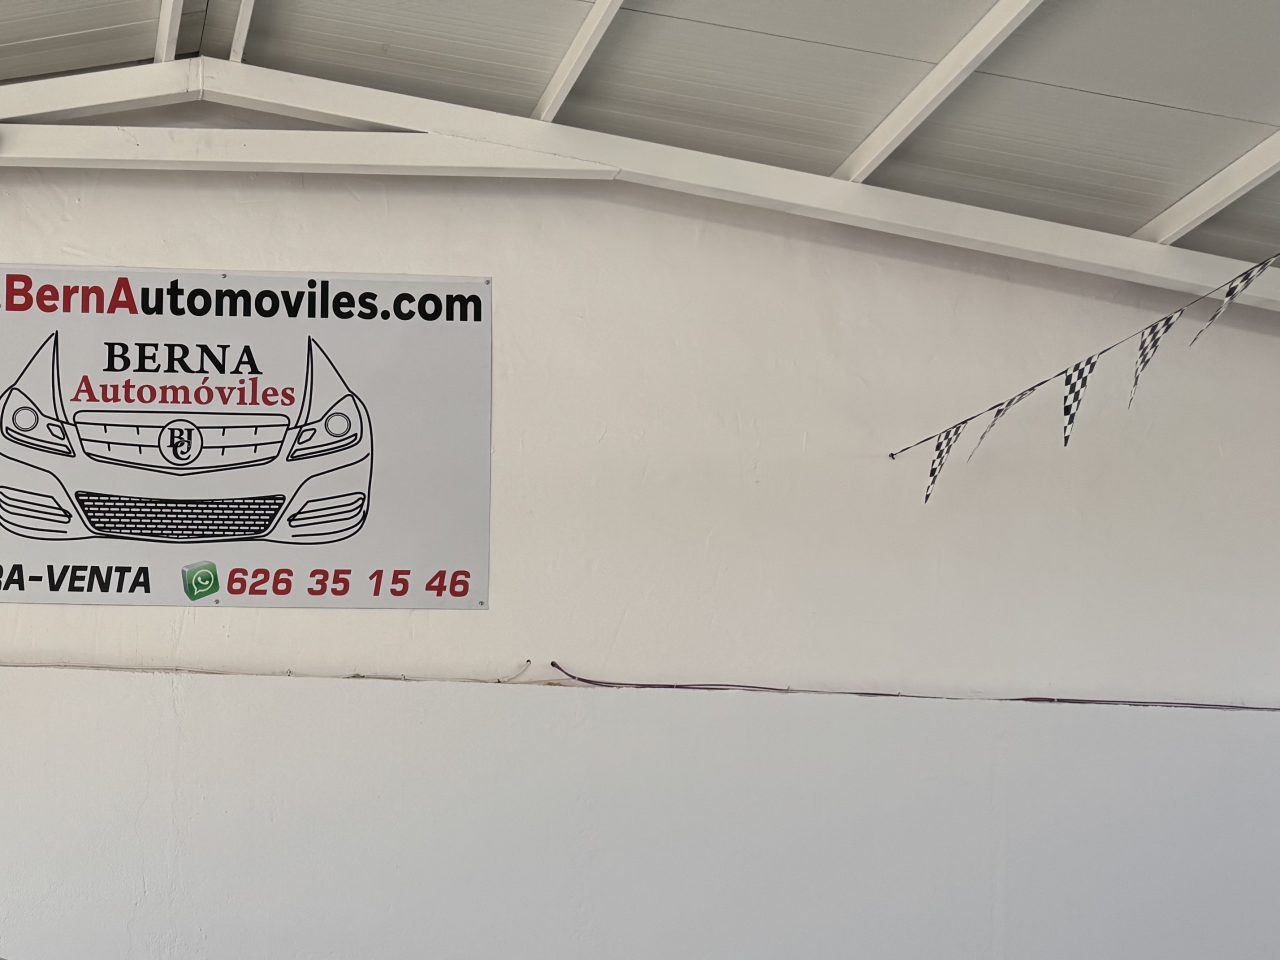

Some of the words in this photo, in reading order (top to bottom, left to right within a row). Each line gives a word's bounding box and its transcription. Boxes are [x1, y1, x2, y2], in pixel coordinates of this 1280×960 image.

[103, 342, 263, 375] BERNA
[70, 372, 296, 407] Automóviles
[226, 568, 293, 596] 626
[307, 569, 352, 597] 35
[369, 570, 411, 597] 15
[425, 570, 471, 598] 46
